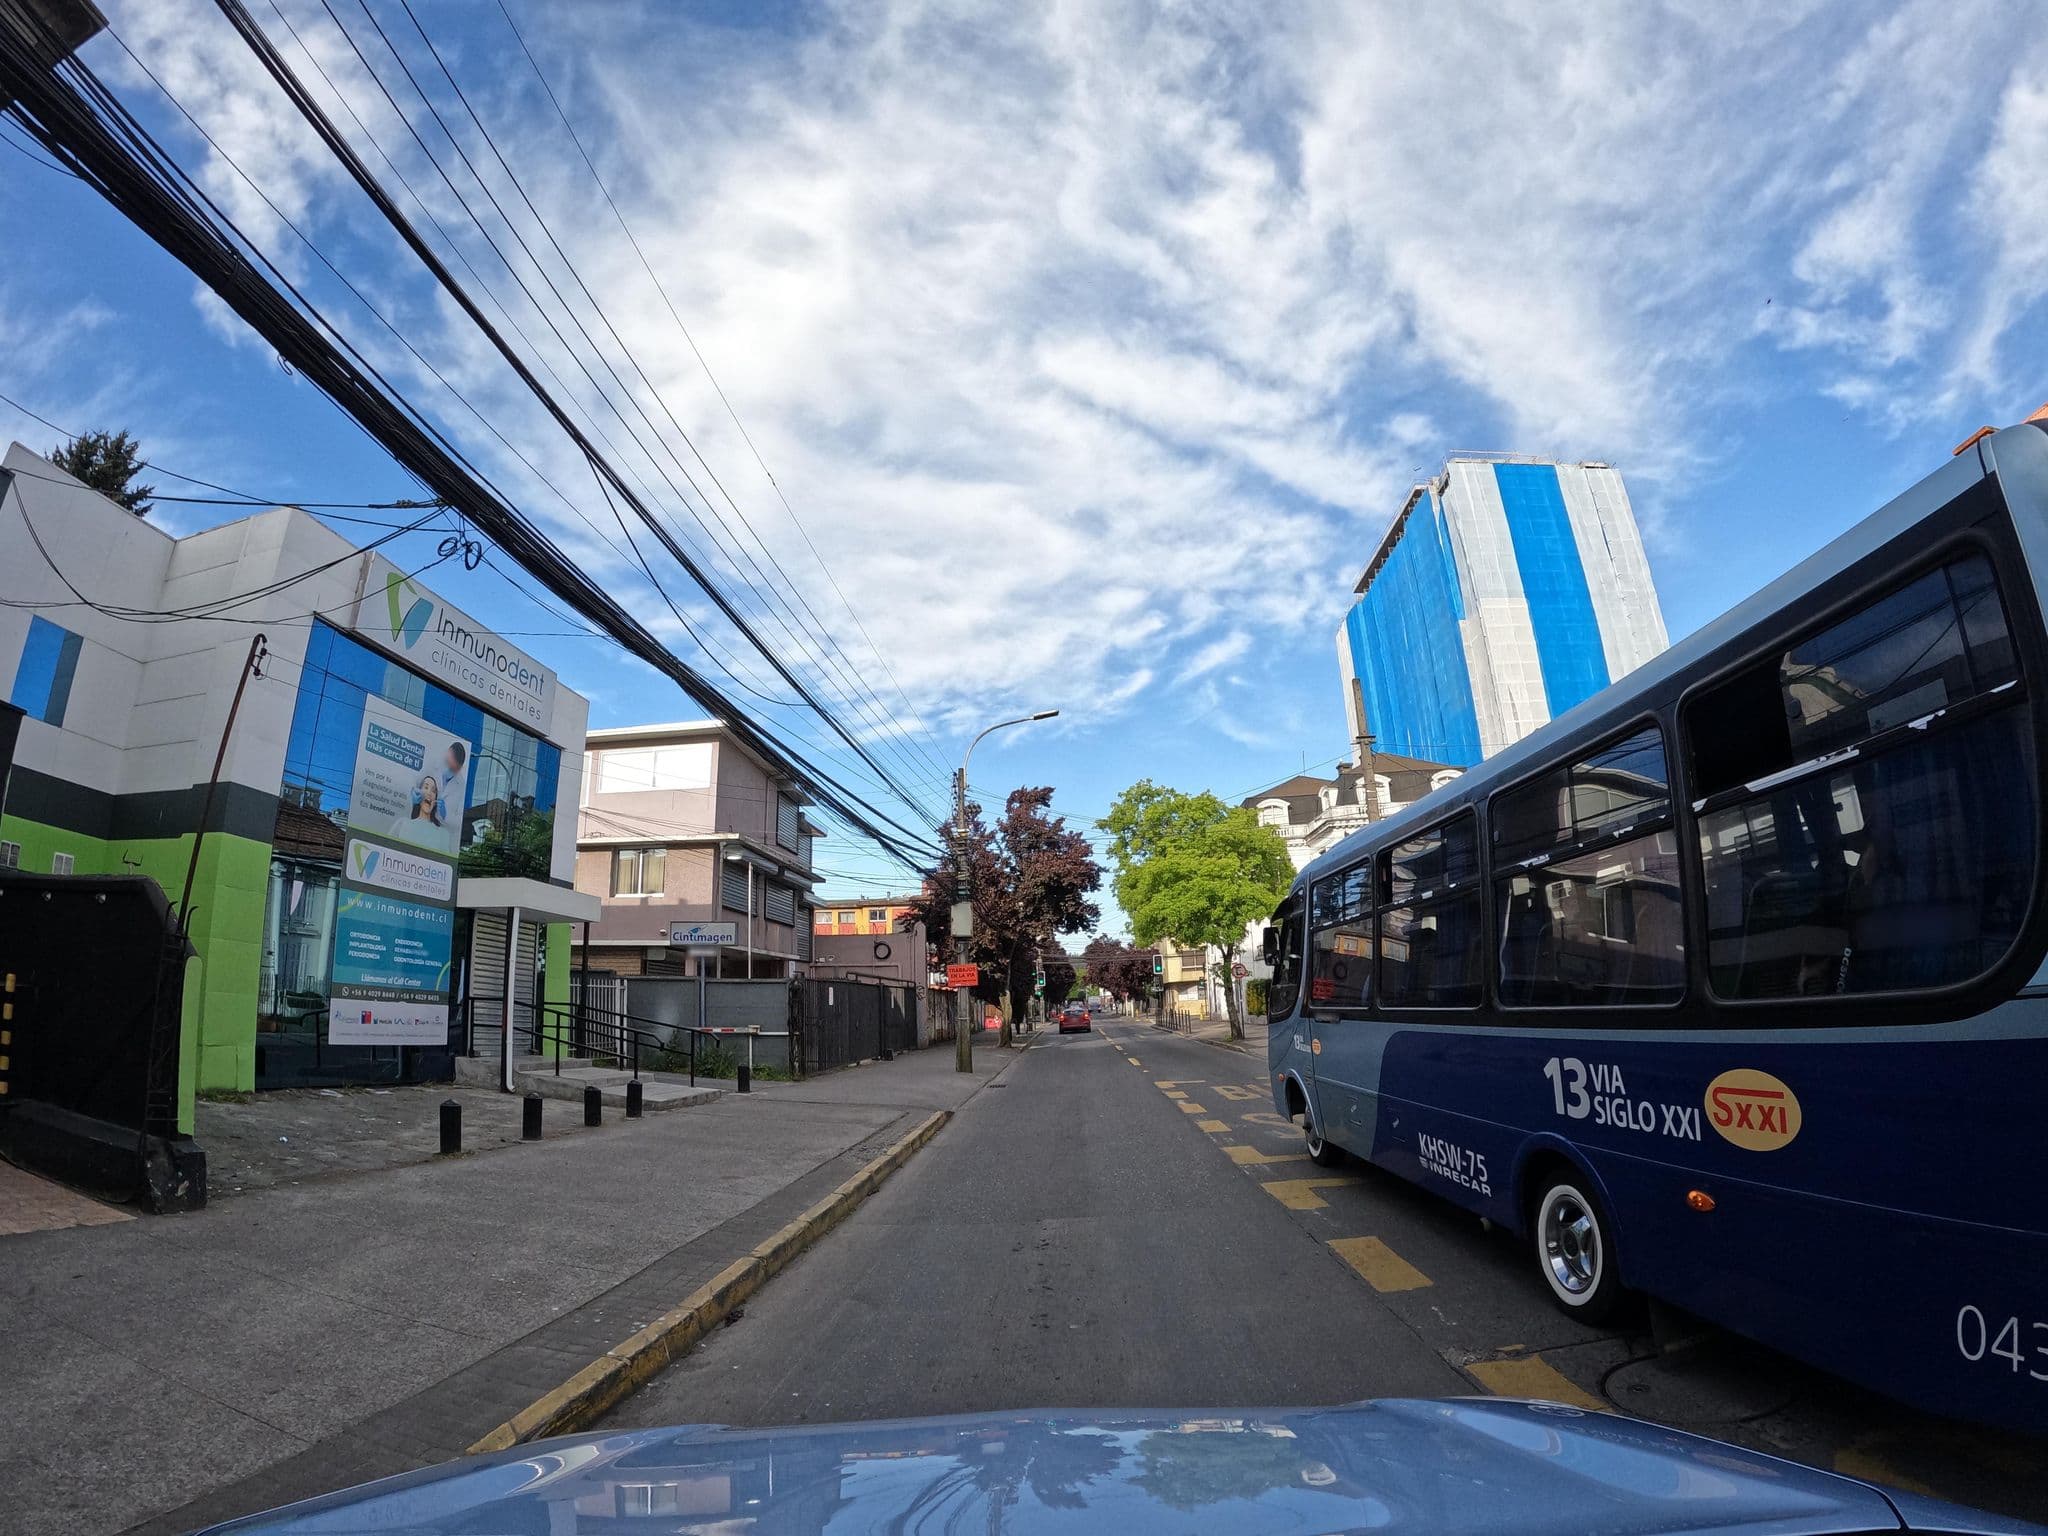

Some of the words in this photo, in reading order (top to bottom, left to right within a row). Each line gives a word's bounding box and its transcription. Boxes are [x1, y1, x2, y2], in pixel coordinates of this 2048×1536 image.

[436, 608, 545, 696] Inmunodent
[489, 682, 543, 720] dentales
[380, 730, 400, 746] Salud
[384, 748, 403, 761] cerca
[382, 852, 447, 882] Inmunodent
[347, 897, 447, 924] www.inmunodent.cl
[1543, 1057, 1591, 1119] 13
[1589, 1063, 1626, 1095] VIA
[1594, 1095, 1656, 1132] SIGLO
[1660, 1103, 1702, 1141] XXI
[1418, 1132, 1488, 1183] KHSW-75
[1429, 1161, 1492, 1198] INRECAR
